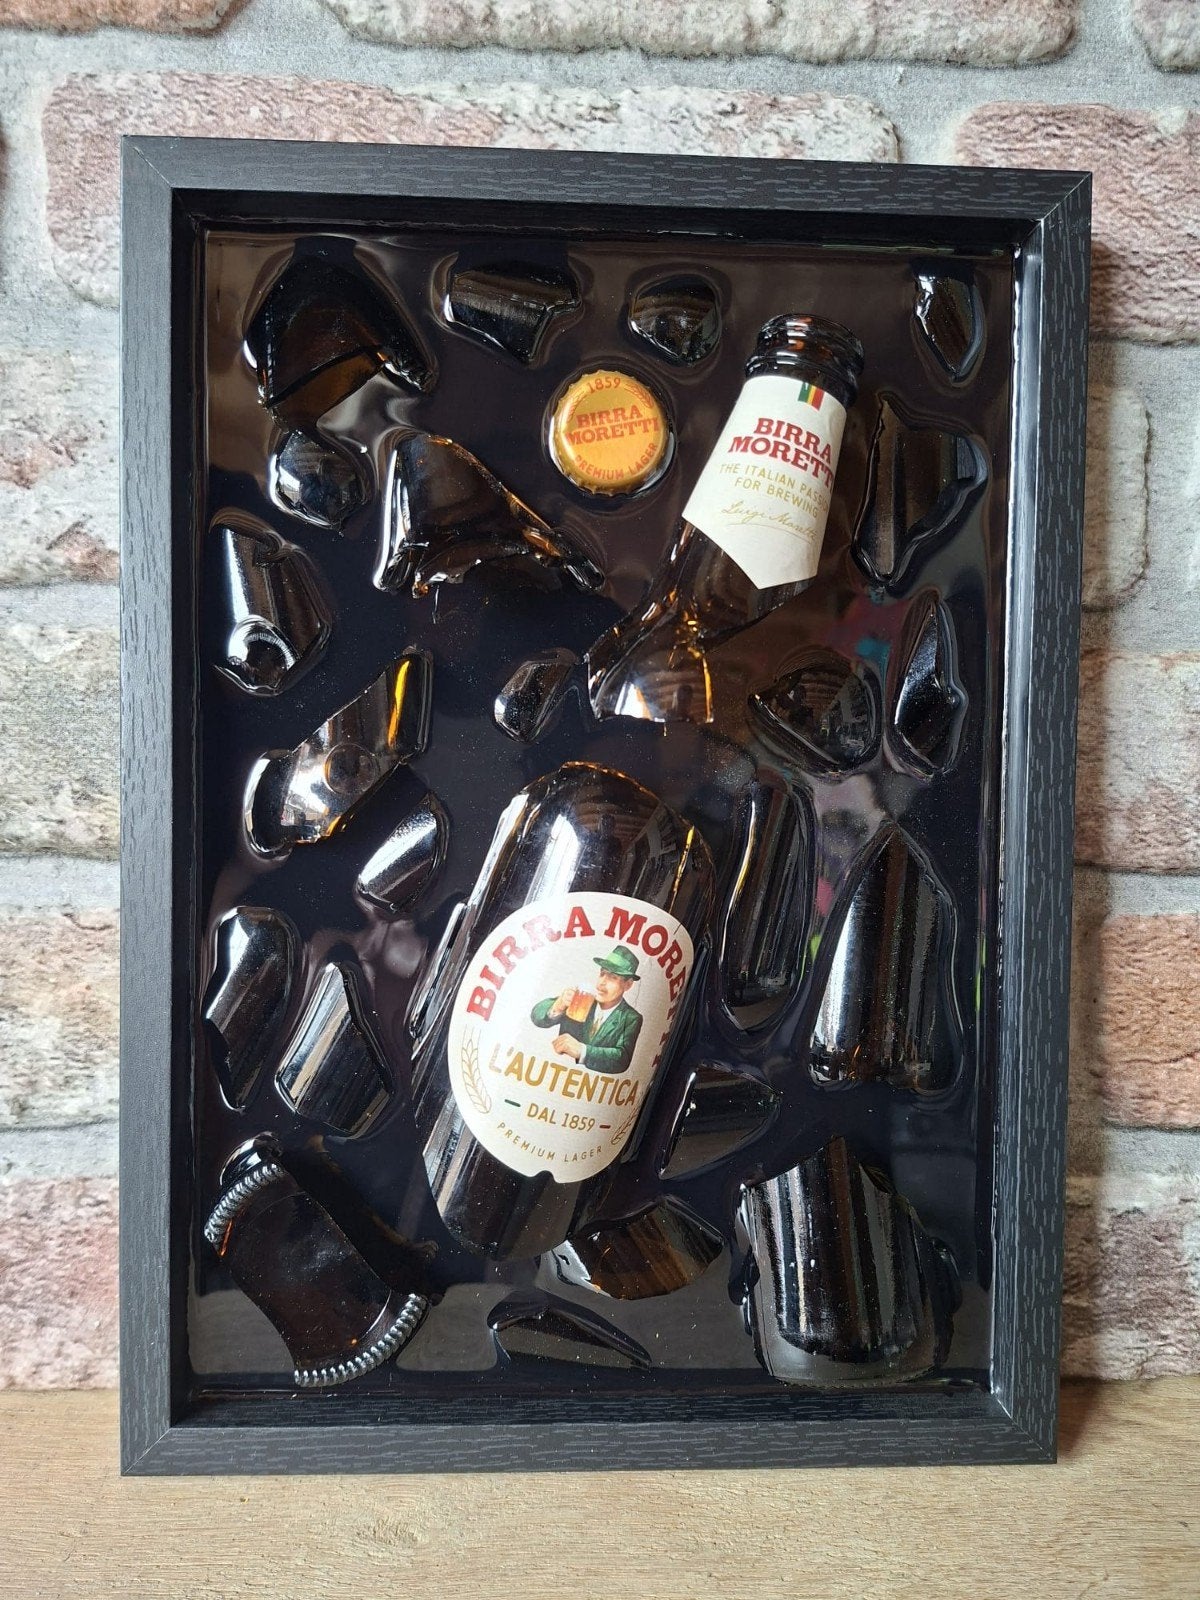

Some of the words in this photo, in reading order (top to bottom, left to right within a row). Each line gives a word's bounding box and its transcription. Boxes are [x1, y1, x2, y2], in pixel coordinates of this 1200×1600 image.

[588, 376, 621, 394] 1859
[565, 417, 660, 445] MORETTI
[576, 404, 643, 428] BIRRA
[753, 417, 832, 465] BIRRA
[575, 454, 625, 480] PREMIUM
[628, 442, 658, 476] LAGER
[719, 463, 738, 475] THE
[744, 465, 796, 490] ITALIAN
[734, 477, 762, 491] FOR
[766, 484, 819, 519] BREWING
[466, 906, 596, 1022] BIRRA
[488, 1043, 639, 1107] L'AUTENTICA
[526, 1103, 557, 1125] DAL
[561, 1112, 596, 1133] 1859
[497, 1121, 555, 1161] PREMIUM
[564, 1145, 603, 1163] LAGER
